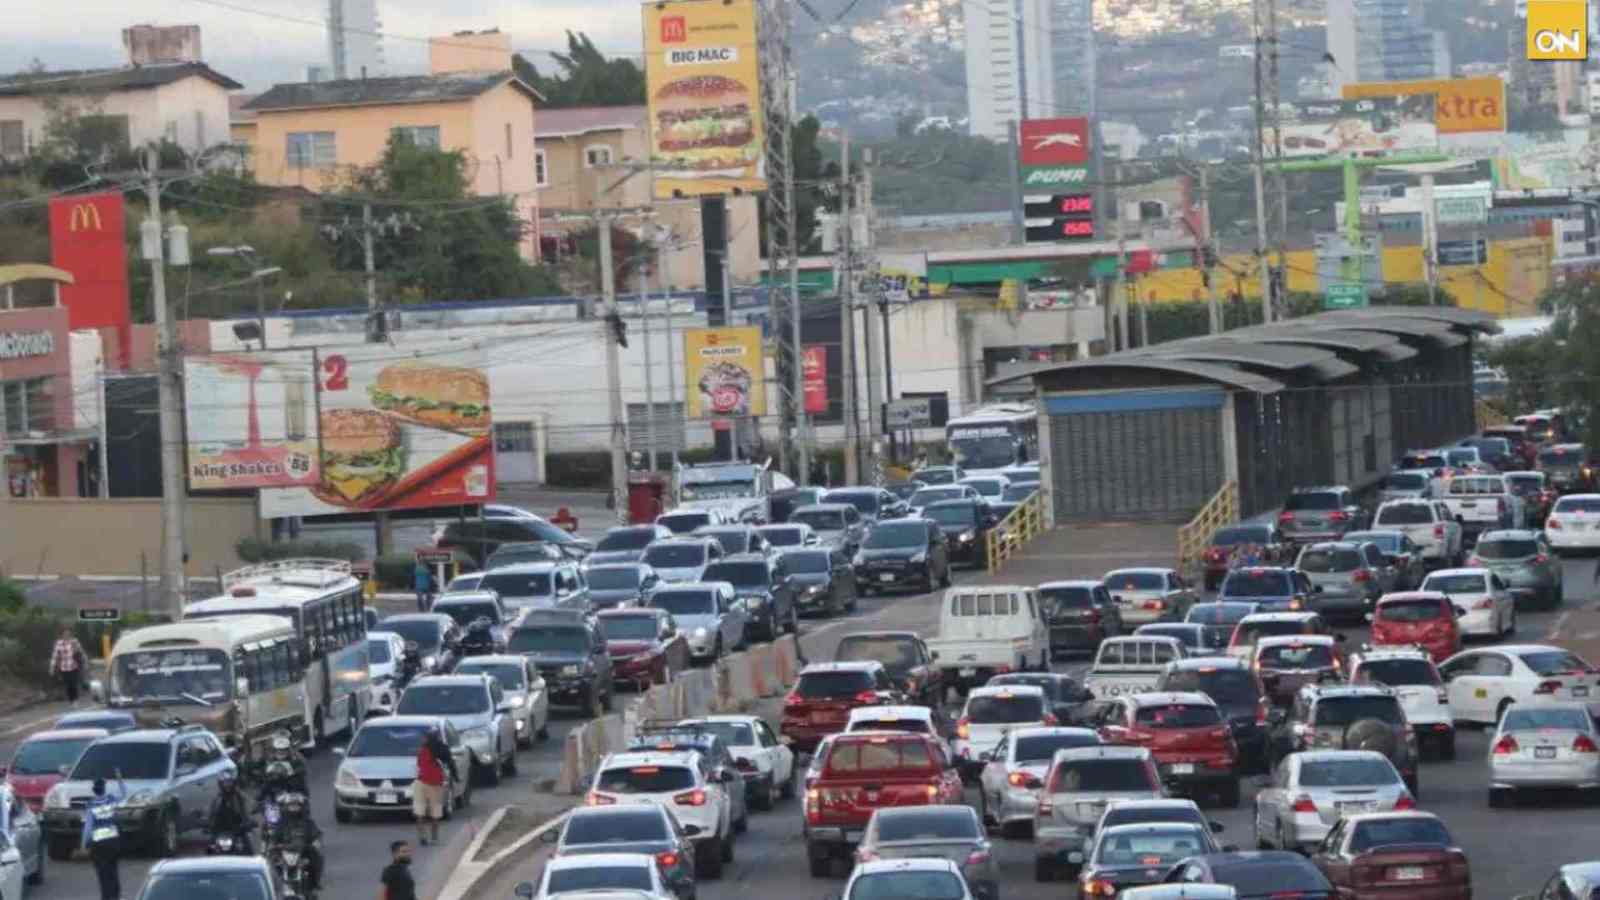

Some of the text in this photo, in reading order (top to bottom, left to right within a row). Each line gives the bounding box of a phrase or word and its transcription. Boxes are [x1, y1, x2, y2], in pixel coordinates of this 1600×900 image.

[671, 48, 729, 63] BIG MAC
[1026, 169, 1088, 184] PUMA
[193, 460, 288, 478] King Shakes
